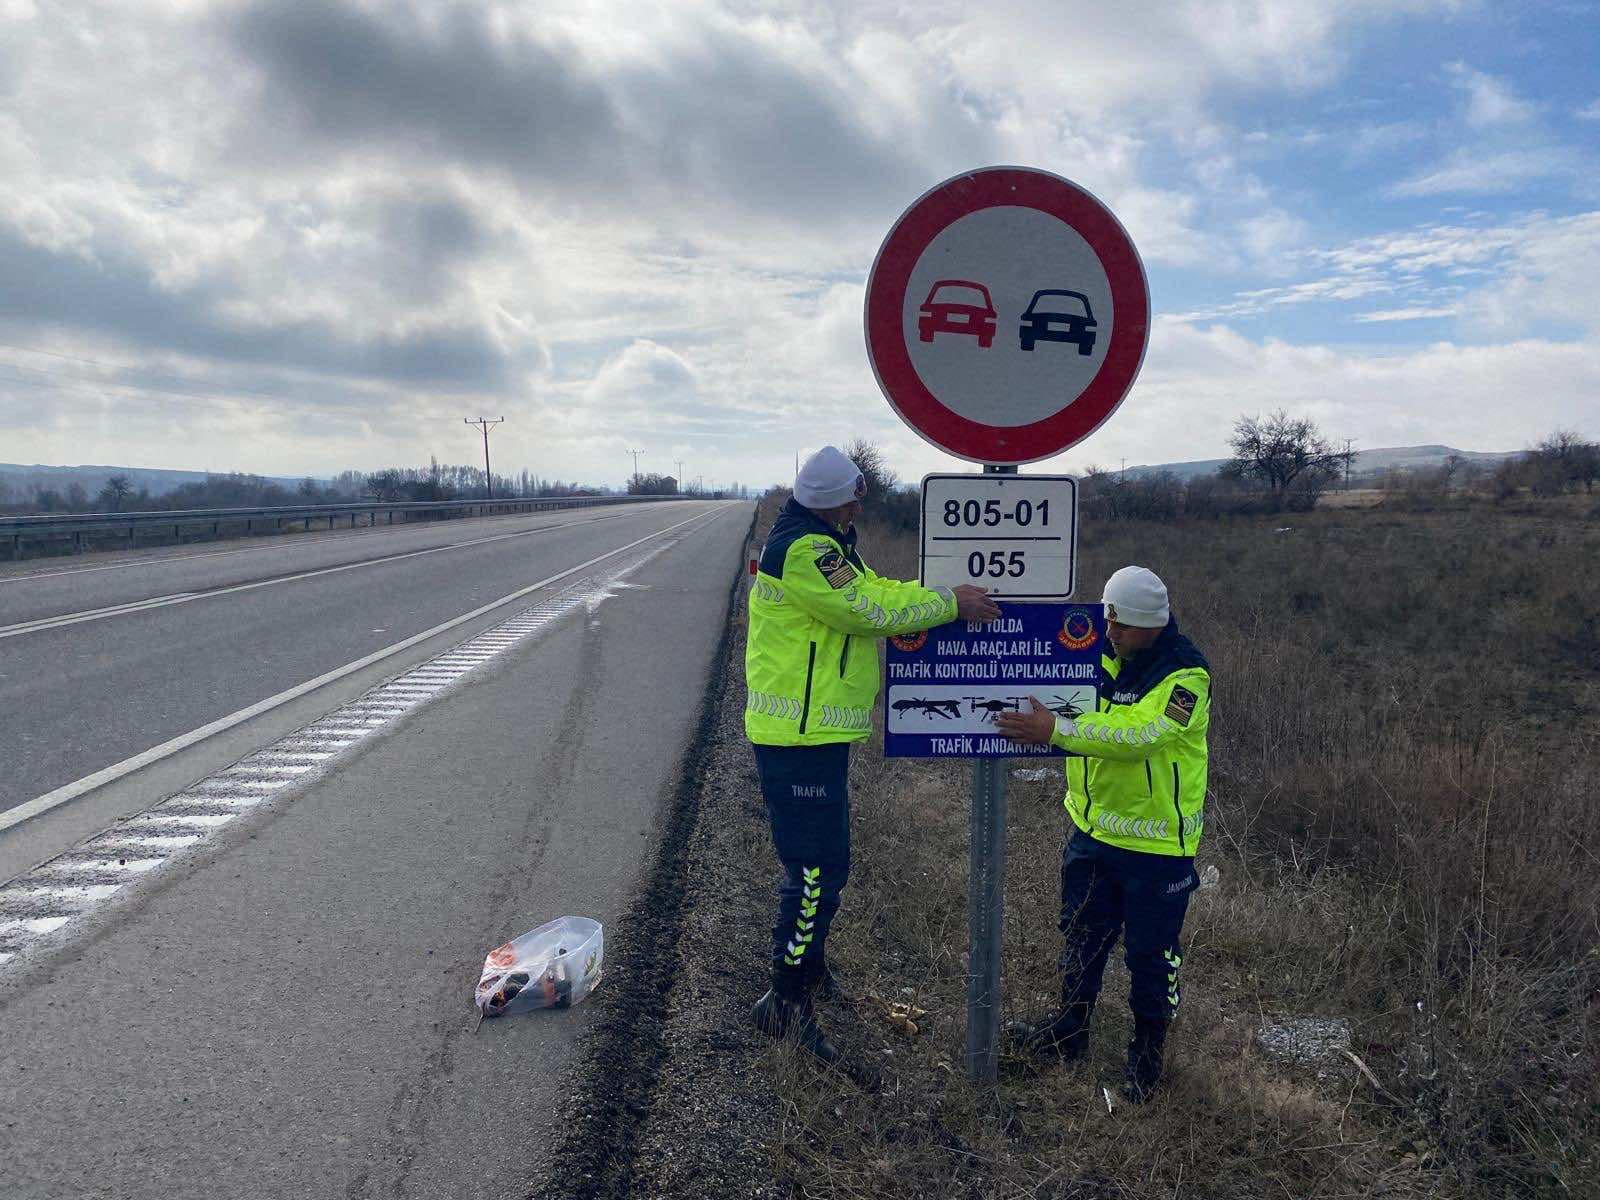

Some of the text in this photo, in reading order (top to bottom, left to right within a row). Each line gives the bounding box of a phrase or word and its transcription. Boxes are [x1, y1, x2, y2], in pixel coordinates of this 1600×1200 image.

[943, 499, 1049, 527] 805-01
[967, 551, 1025, 578] 055
[967, 618, 1024, 633] BU YOLDA
[937, 640, 968, 656] HAVA
[971, 640, 1031, 659] ARAÇLARI
[1033, 637, 1052, 656] İLE
[889, 660, 1098, 679] TRAFİK KONTROLÜ YAPILMAKTADIR.
[930, 735, 973, 754] TRAFİK
